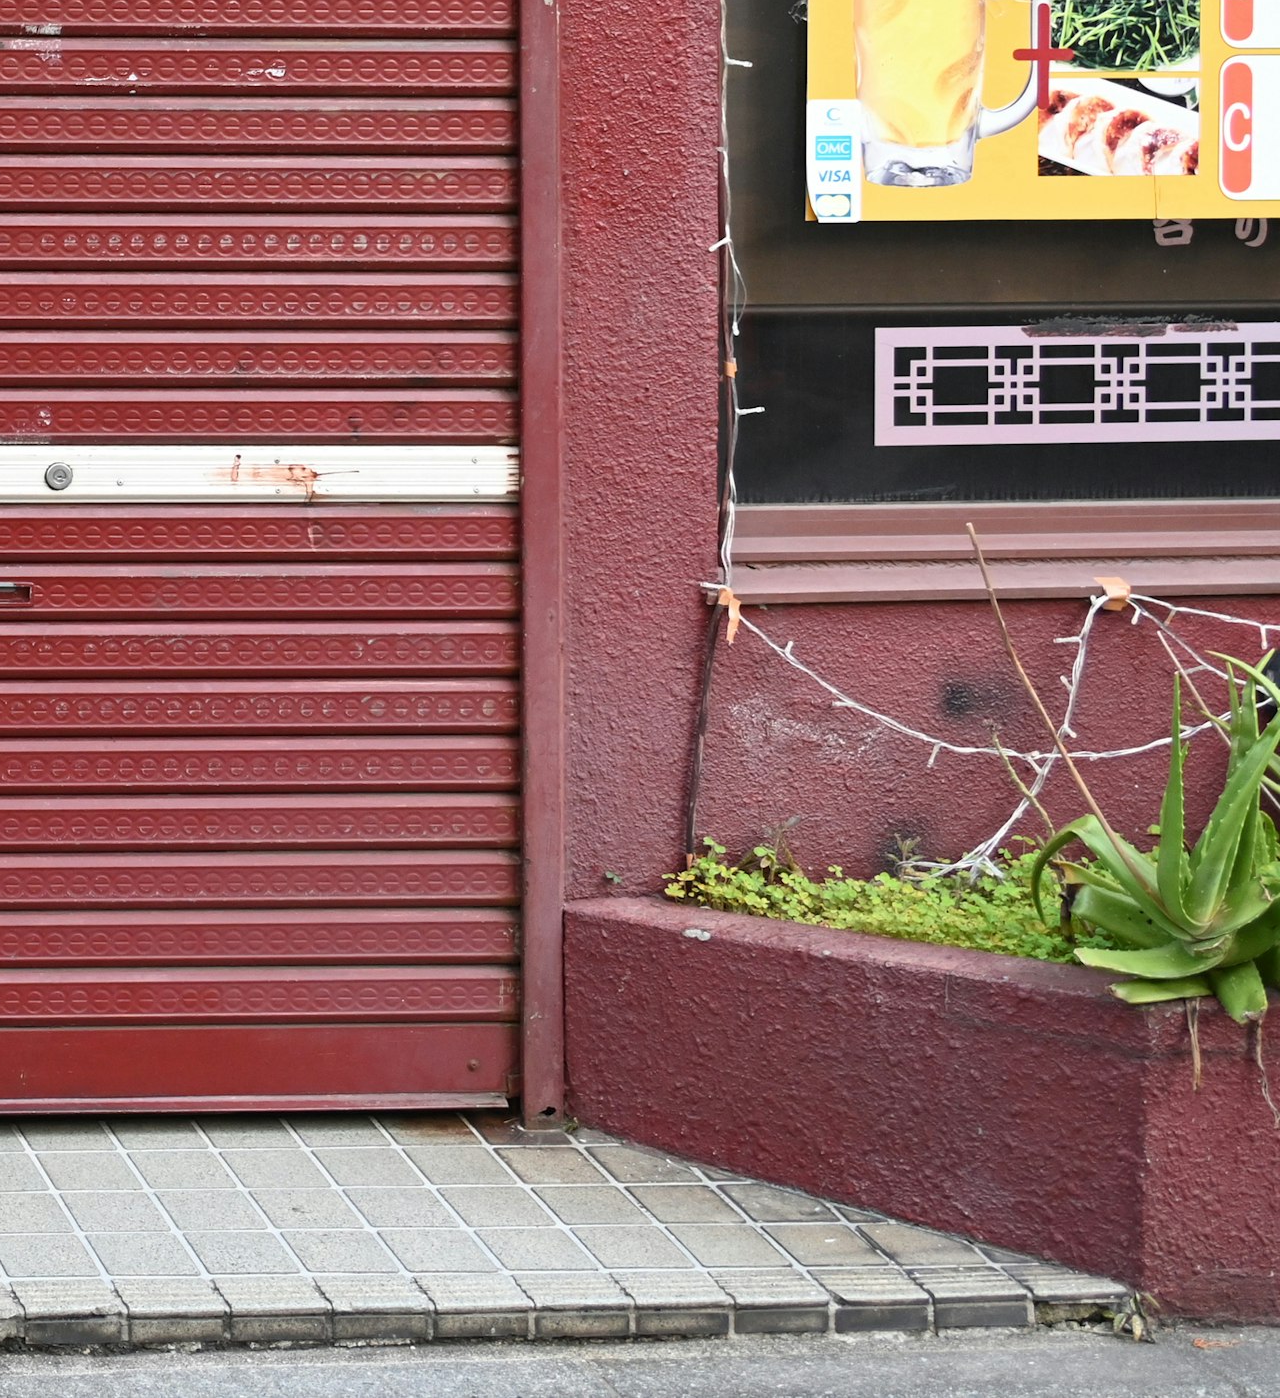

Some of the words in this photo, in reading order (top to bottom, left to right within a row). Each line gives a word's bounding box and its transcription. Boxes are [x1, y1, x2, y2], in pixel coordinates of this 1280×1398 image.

[1223, 102, 1251, 153] C
[816, 142, 850, 155] OMC
[818, 170, 851, 182] VISA
